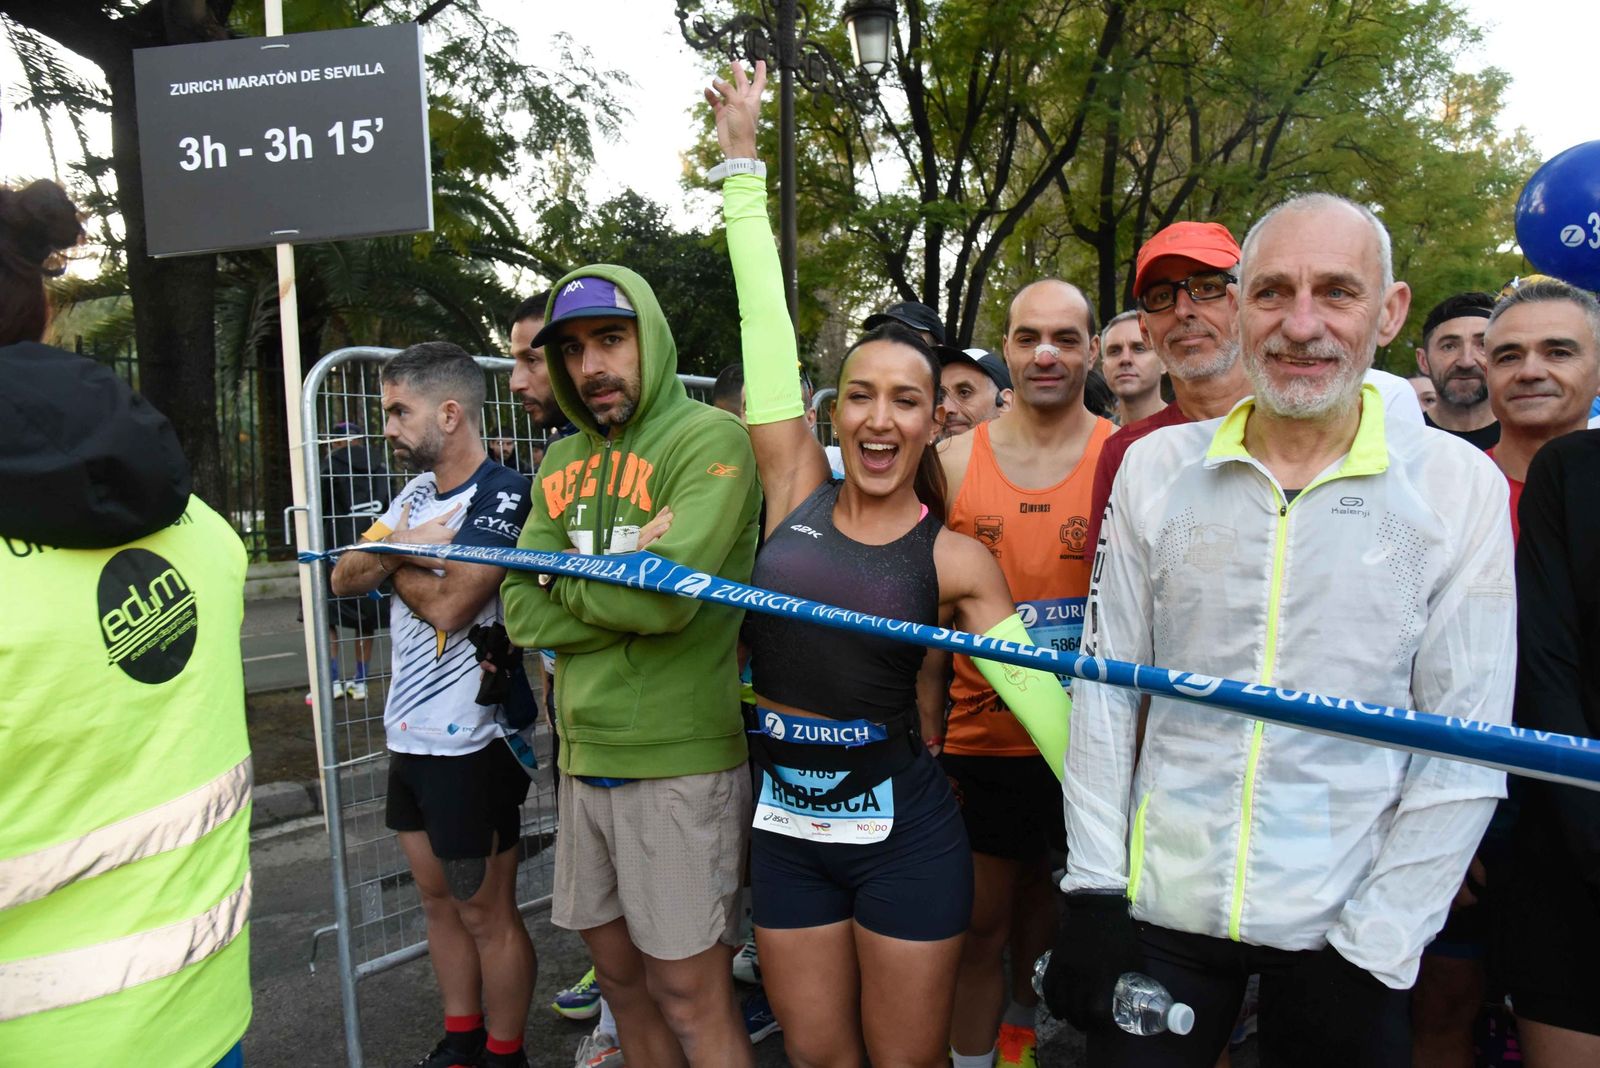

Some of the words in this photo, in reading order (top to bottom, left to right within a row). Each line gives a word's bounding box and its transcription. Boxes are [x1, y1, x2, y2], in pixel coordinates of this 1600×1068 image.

[170, 79, 223, 95] ZURICH
[227, 70, 297, 90] MARATÓN
[301, 69, 321, 82] DE
[324, 62, 385, 80] SEVILLA
[178, 135, 228, 171] 3h
[264, 126, 313, 162] 3h
[327, 117, 384, 155] 15'
[790, 524, 823, 539] 42K
[454, 545, 504, 561] ZURICH
[559, 557, 627, 580] SEVILLA
[102, 568, 186, 642] edym
[710, 584, 809, 613] ZURICH
[792, 724, 870, 743] ZURICH
